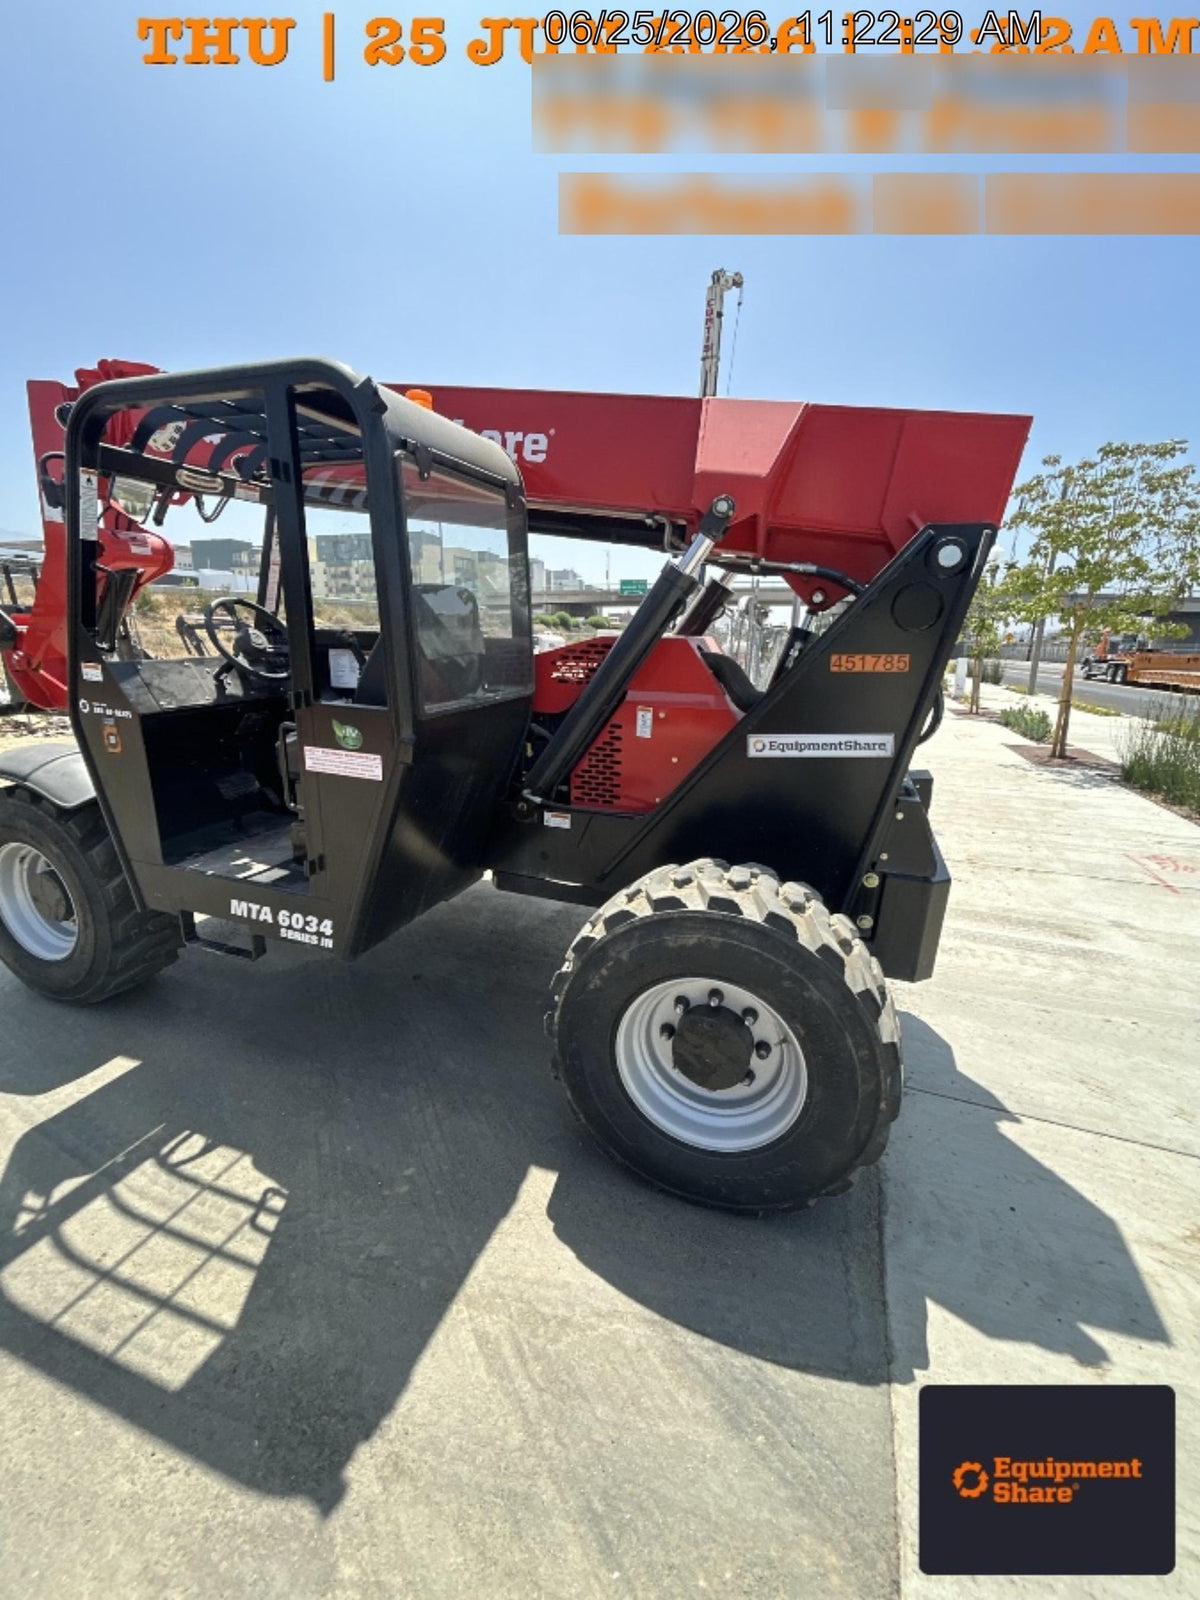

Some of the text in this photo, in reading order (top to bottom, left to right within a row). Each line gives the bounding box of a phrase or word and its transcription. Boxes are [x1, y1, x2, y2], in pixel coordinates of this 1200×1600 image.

[831, 655, 908, 671] 451785
[768, 740, 886, 753] EquipmentShare
[230, 899, 333, 936] MTA 6034
[280, 927, 319, 945] SERIES
